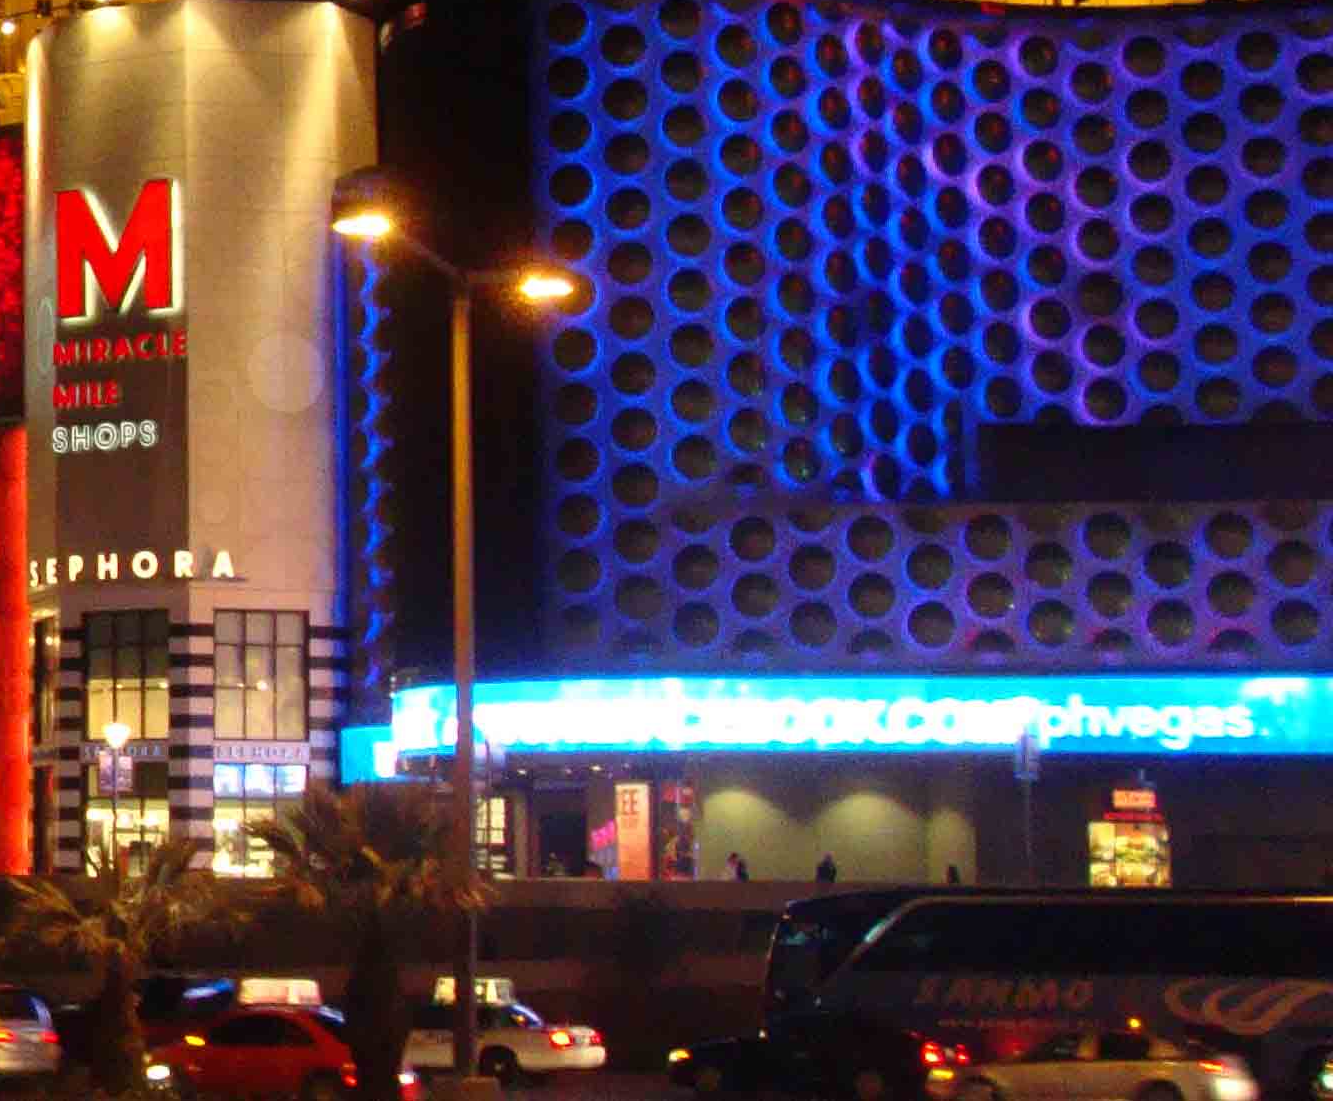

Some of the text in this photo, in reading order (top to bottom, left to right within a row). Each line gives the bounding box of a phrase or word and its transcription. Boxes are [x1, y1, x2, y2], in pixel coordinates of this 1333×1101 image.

[56, 179, 181, 321] M
[53, 329, 188, 366] MIRACLE
[53, 380, 120, 409] MILE
[52, 420, 157, 453] SHOPS
[29, 550, 235, 588] SEPHORA
